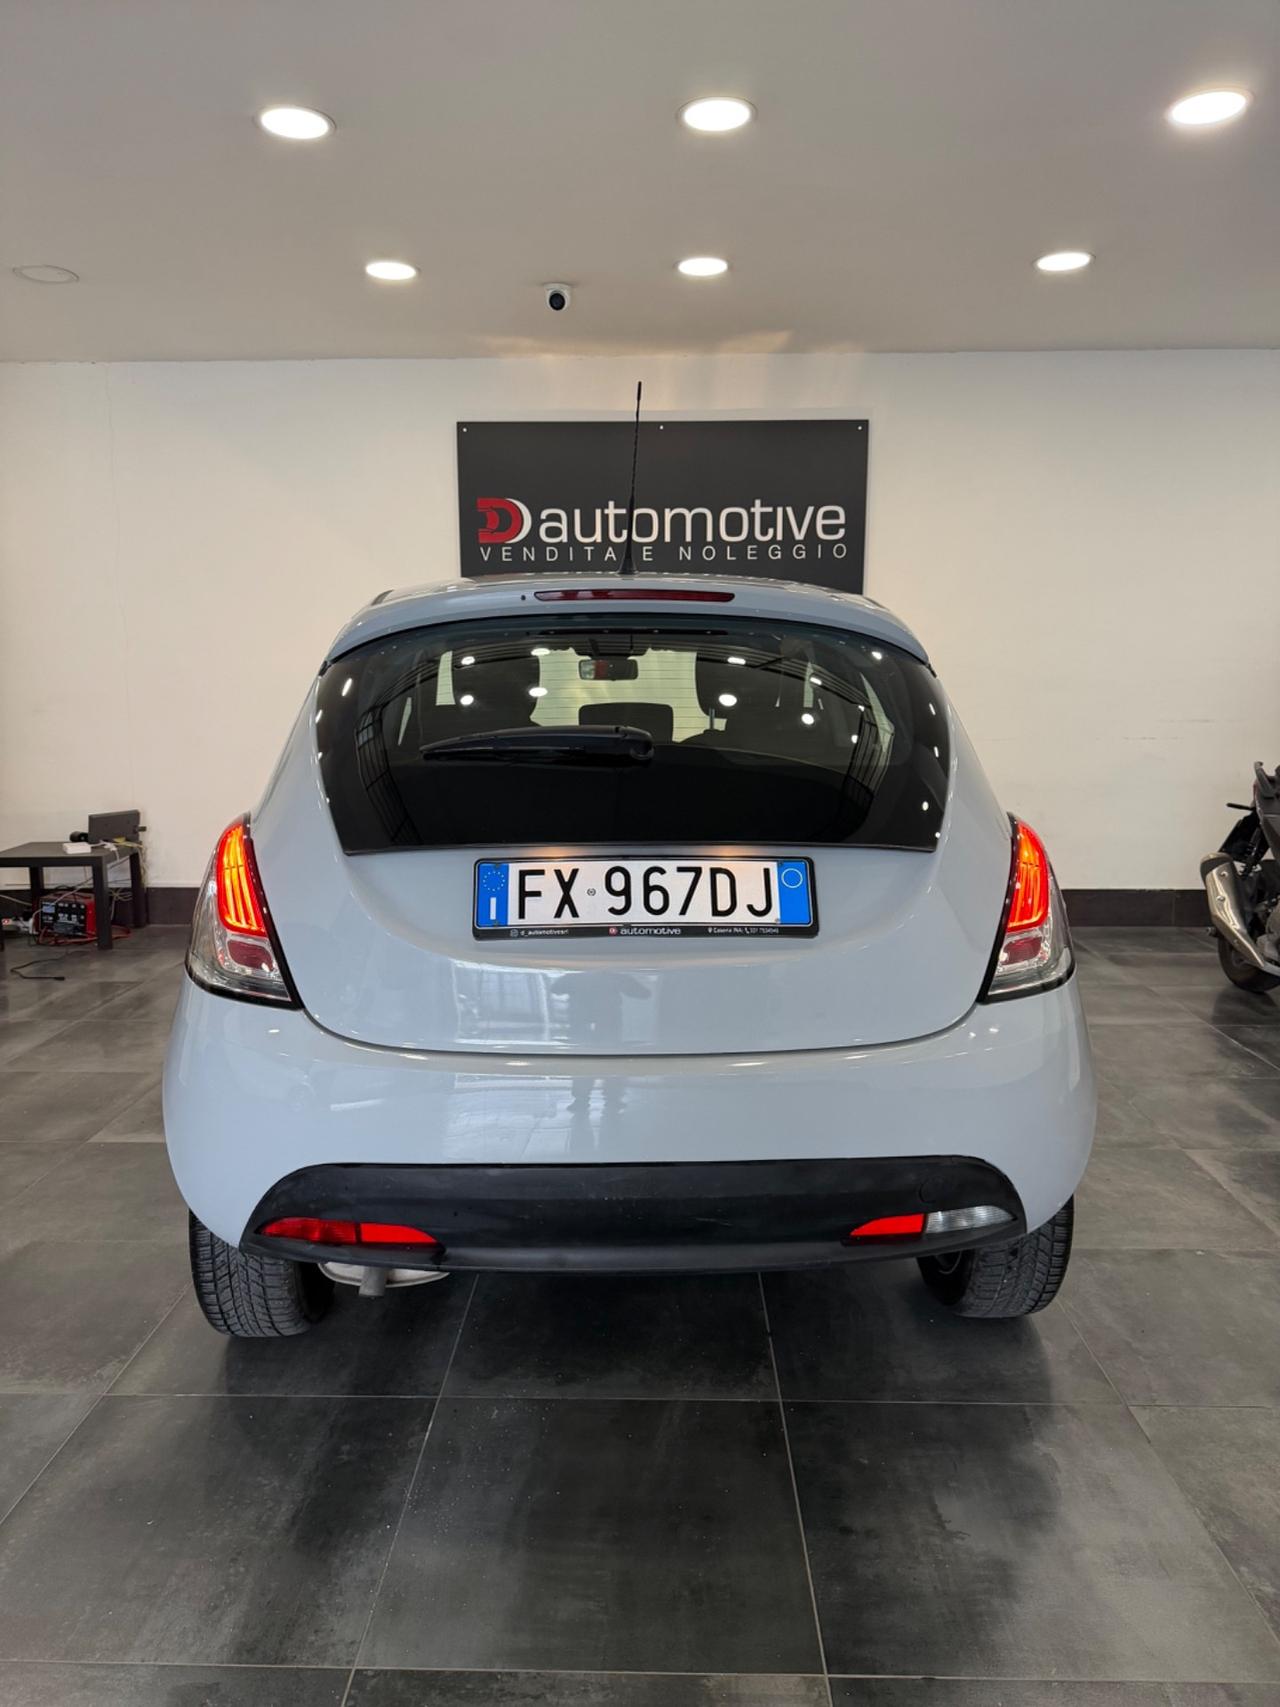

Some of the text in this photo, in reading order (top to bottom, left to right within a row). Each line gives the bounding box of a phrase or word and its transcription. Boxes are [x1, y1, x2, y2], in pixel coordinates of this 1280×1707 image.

[540, 499, 846, 543] automotive
[480, 543, 847, 562] VENDITA E NOLEGGIO
[518, 866, 772, 919] FX 967DJ
[490, 897, 497, 920] I
[620, 927, 681, 935] automotive
